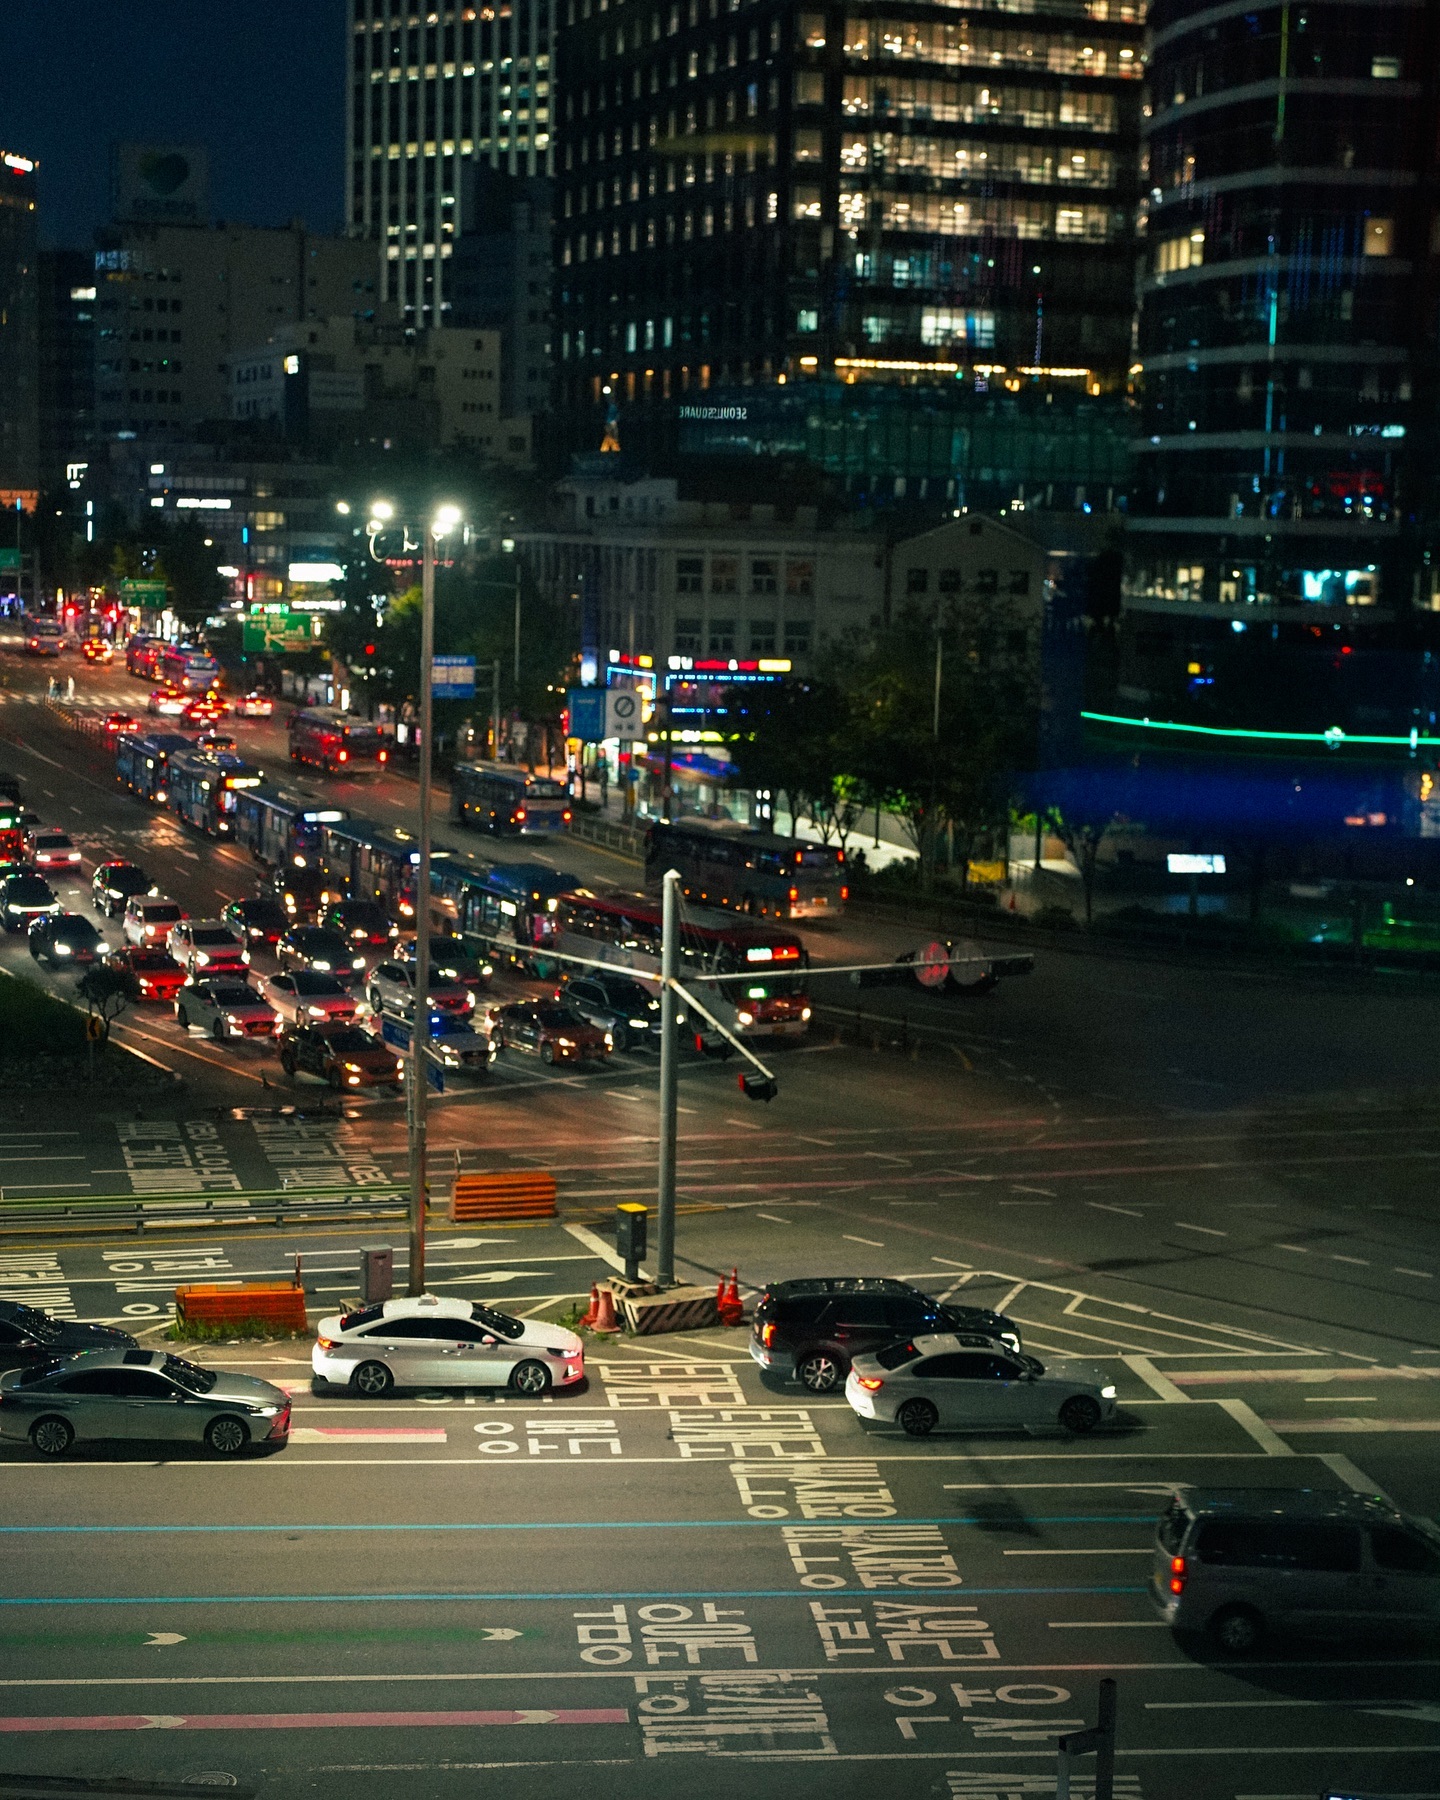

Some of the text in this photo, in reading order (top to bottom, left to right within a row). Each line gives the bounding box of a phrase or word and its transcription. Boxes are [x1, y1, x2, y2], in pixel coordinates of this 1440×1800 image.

[600, 1364, 749, 1407] 퇴계로
[473, 1420, 622, 1455] 명동
[668, 1410, 827, 1458] 퇴계로
[573, 1602, 758, 1666] 후암동
[810, 1601, 1002, 1661] 소월로
[884, 1683, 1088, 1740] 용산
